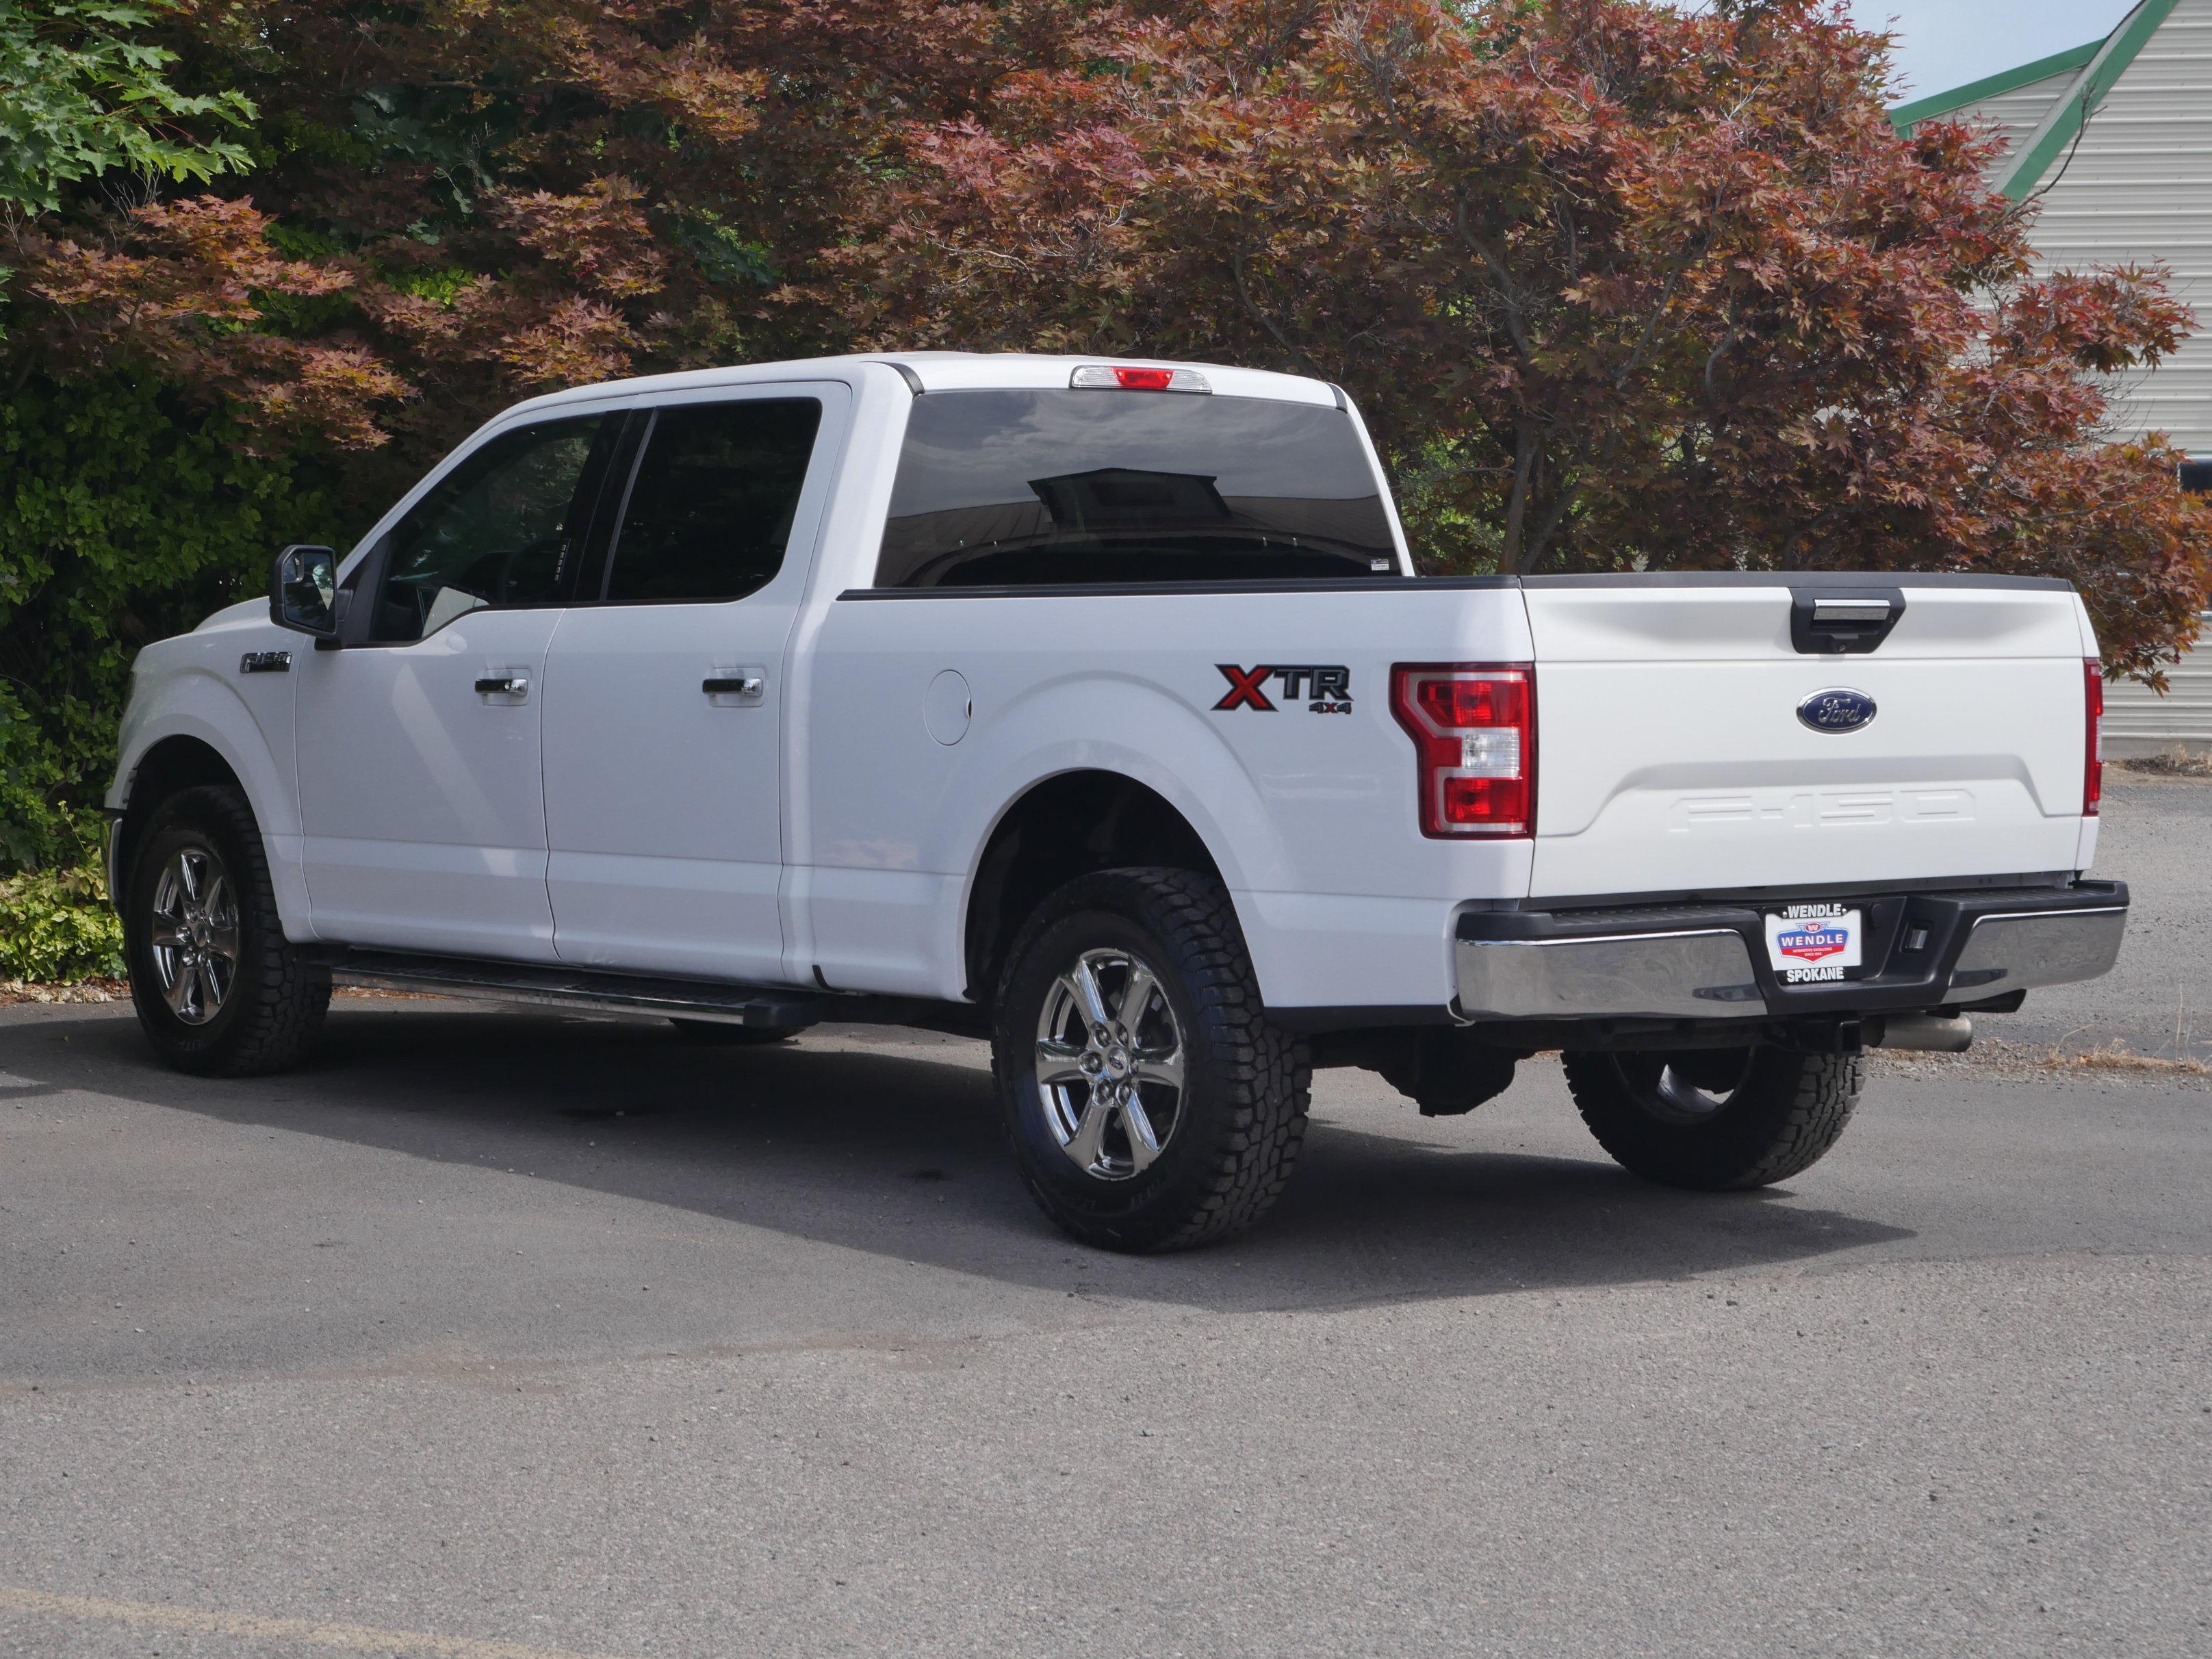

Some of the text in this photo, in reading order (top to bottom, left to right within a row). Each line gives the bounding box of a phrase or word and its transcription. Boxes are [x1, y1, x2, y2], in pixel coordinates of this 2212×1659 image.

[1210, 663, 1354, 712] XTR
[1818, 697, 1861, 723] Ford
[1668, 788, 1977, 832] F-150
[1787, 903, 1842, 918] WENDLE
[1781, 934, 1844, 947] WENDLE
[1786, 966, 1844, 983] SPOKANE
